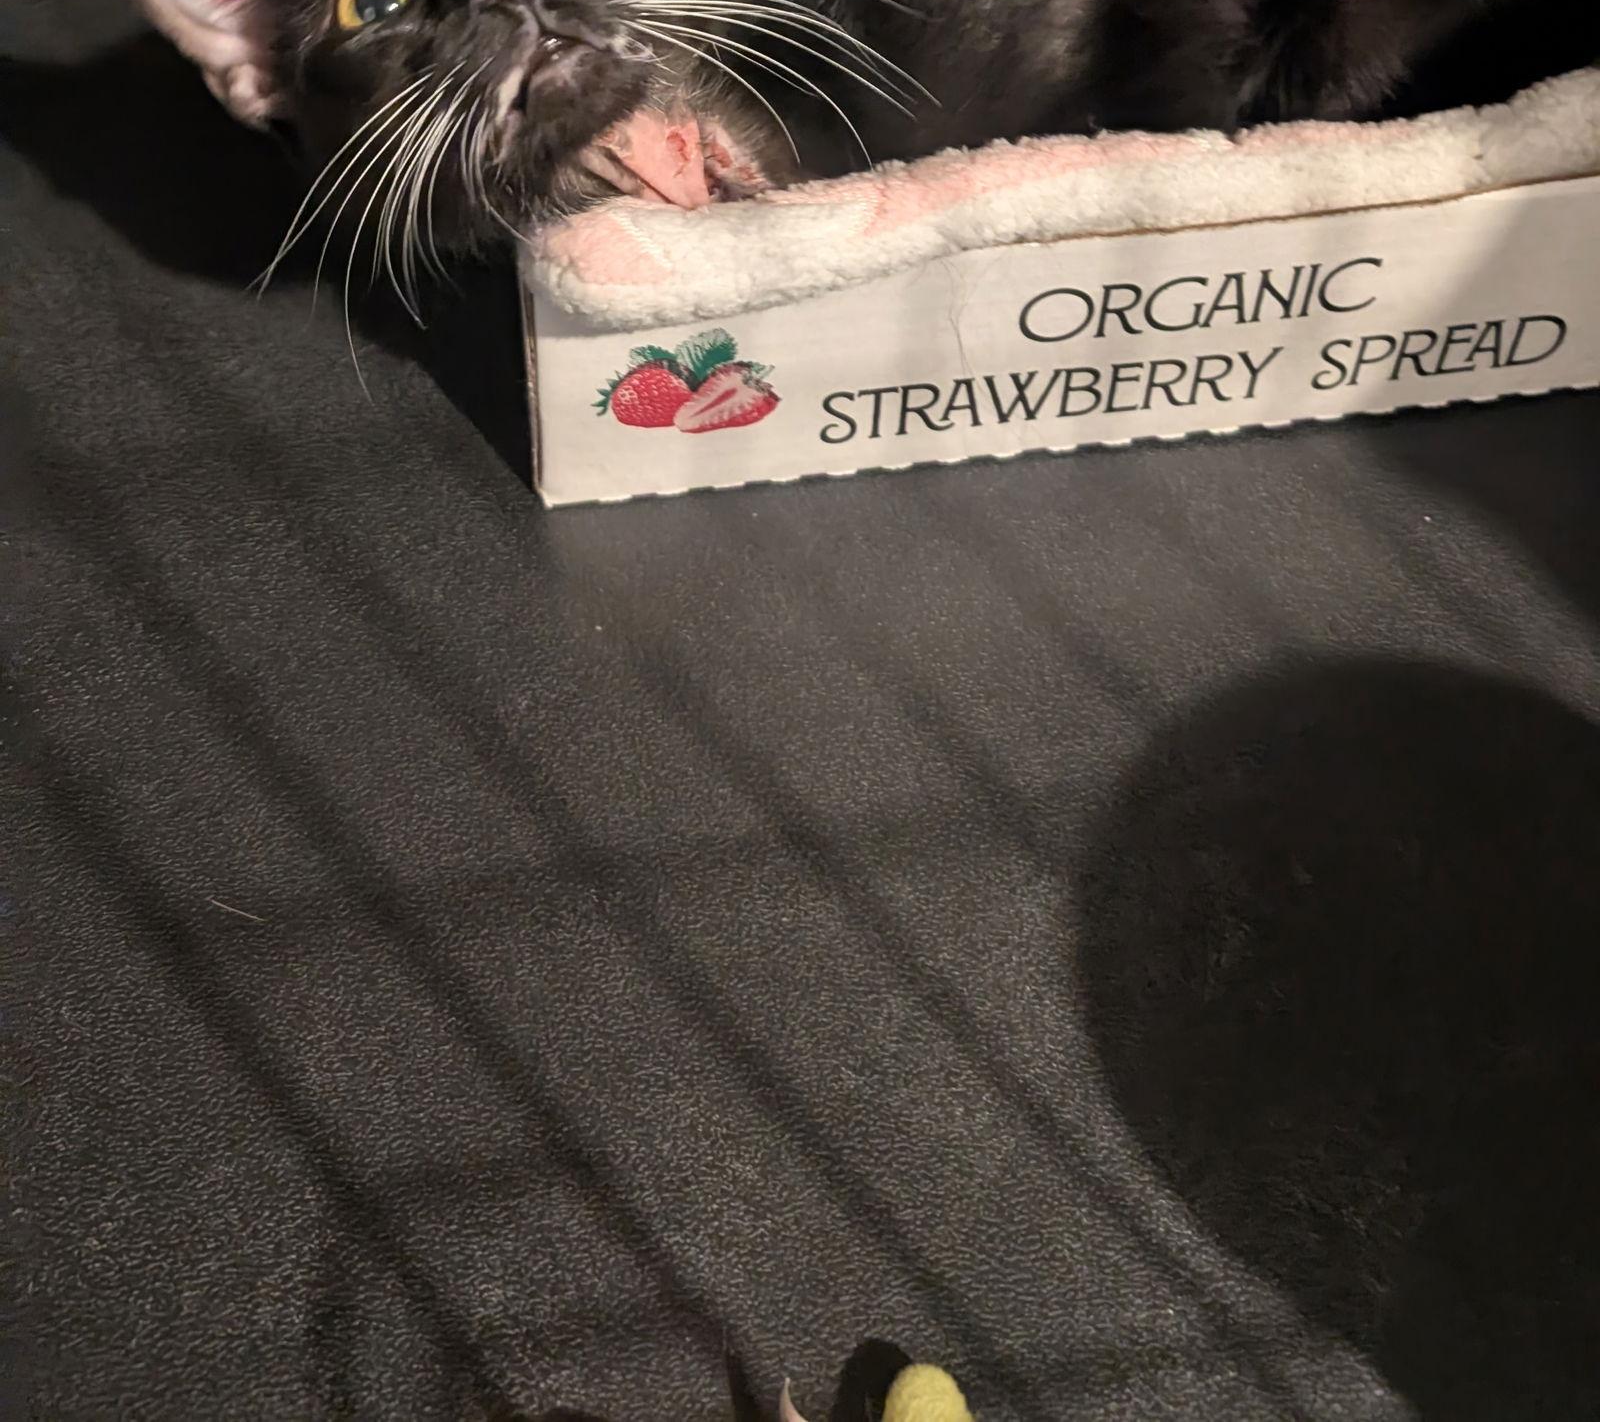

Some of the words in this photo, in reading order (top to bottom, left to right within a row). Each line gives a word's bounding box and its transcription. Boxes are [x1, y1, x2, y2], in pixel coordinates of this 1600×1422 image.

[1019, 258, 1383, 343] ORGANIC
[820, 346, 1282, 443] STRAWBERRY
[1311, 315, 1567, 391] SPREAD
